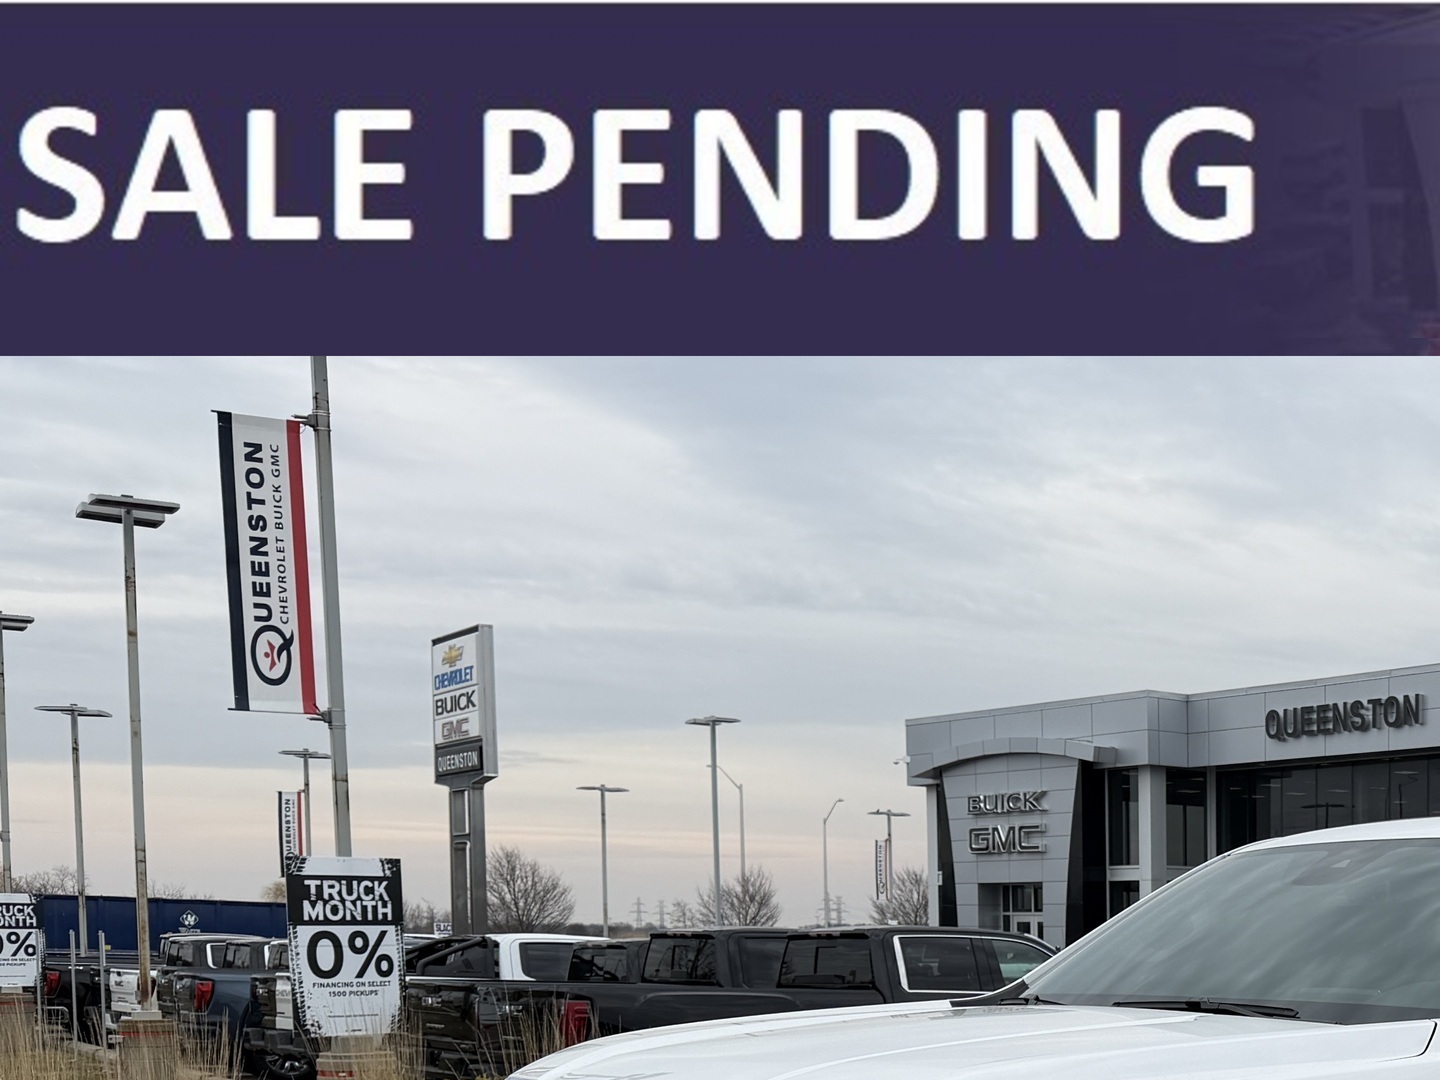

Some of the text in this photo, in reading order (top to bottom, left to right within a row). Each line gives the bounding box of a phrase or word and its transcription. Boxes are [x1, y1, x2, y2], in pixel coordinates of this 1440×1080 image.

[270, 444, 289, 625] CHEVROLET BUICK GMC
[243, 441, 294, 687] QUEENSTON
[434, 665, 474, 691] CHEVROLET
[435, 689, 476, 716] BUICK
[441, 717, 470, 741] GMC
[1265, 692, 1425, 743] QUEENSTON
[438, 751, 478, 772] QUEENSTON
[967, 790, 1048, 815] BUICK
[284, 798, 295, 857] UEENSTON
[968, 824, 1046, 854] GMC
[303, 879, 390, 901] TRUCK
[0, 905, 34, 916] UCK
[302, 899, 393, 921] MONTH
[307, 930, 394, 979] 0%
